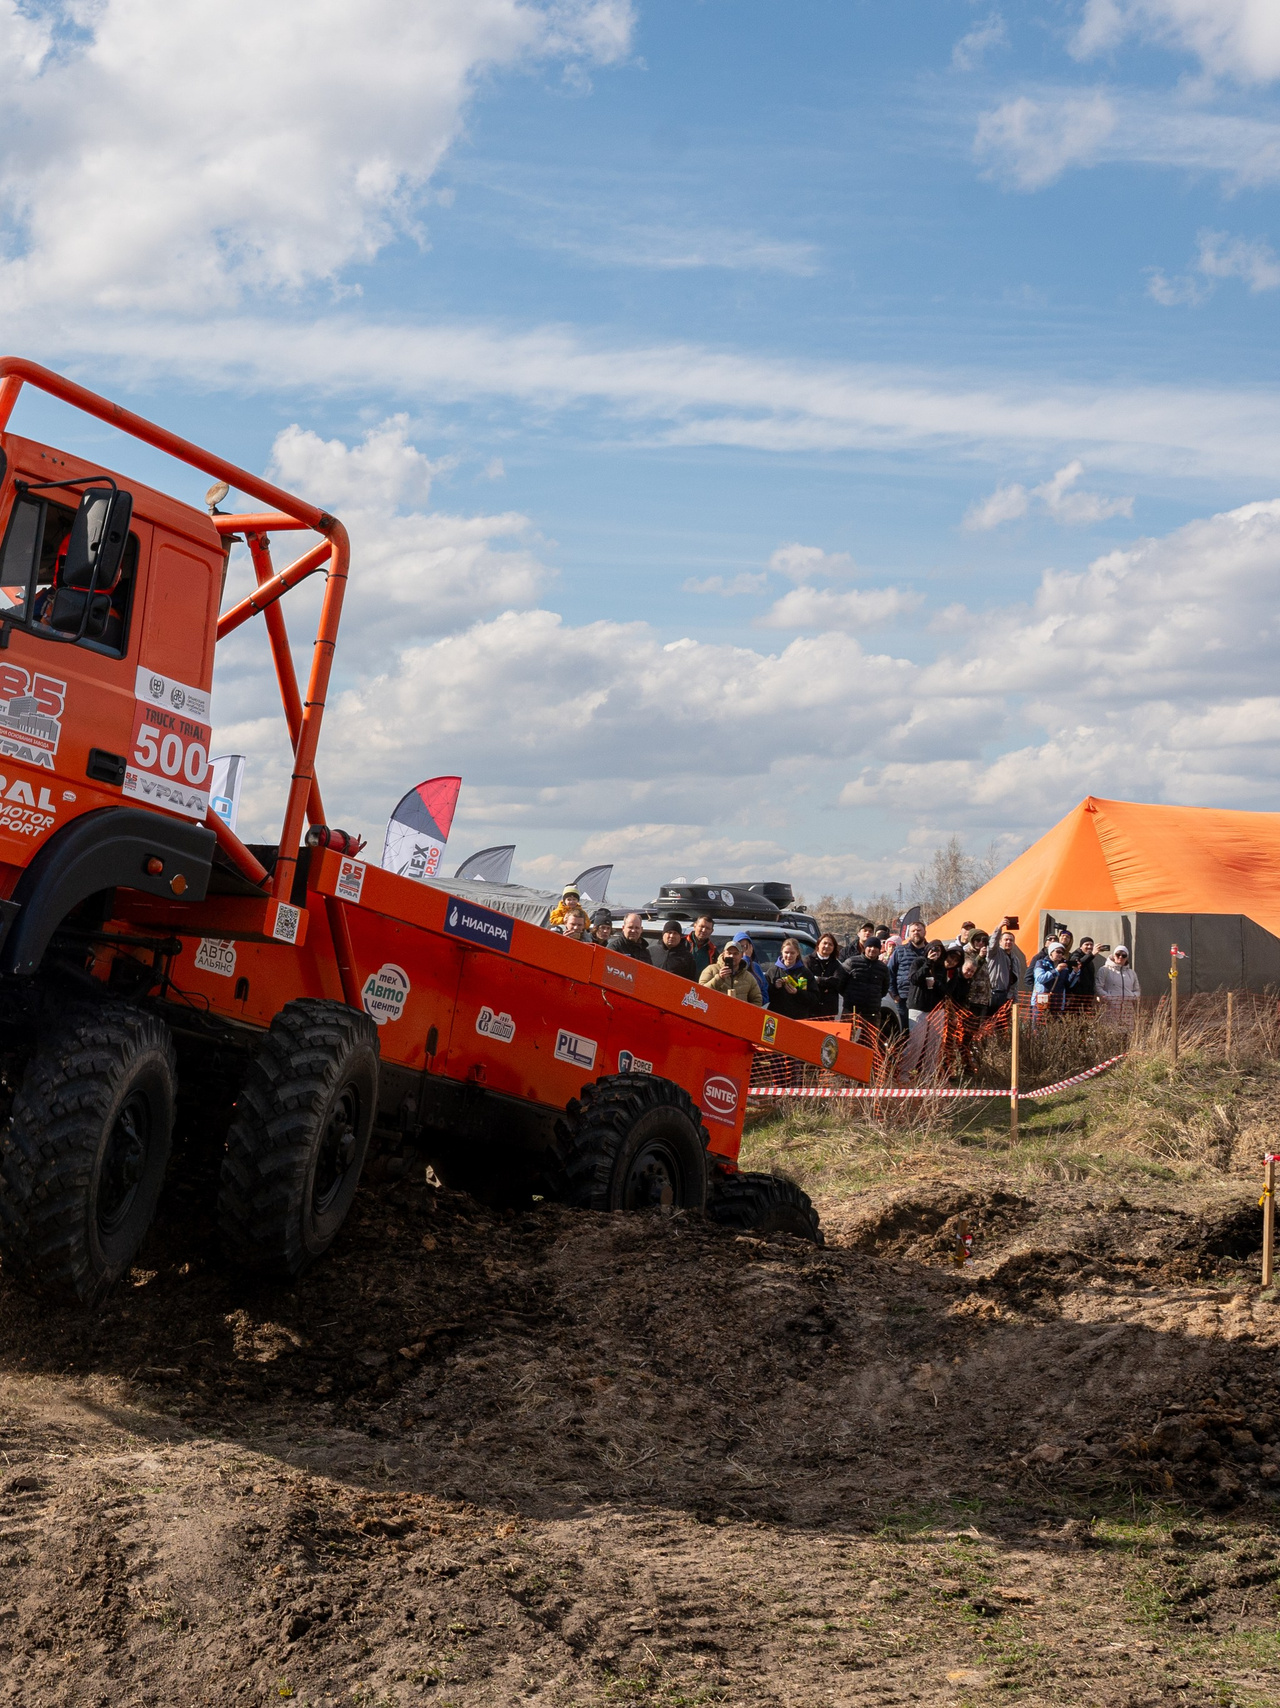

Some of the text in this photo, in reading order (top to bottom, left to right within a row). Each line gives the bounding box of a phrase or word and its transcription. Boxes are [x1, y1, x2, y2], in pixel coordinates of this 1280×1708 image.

[145, 708, 206, 742] TRUCK TRIAL
[133, 723, 209, 785] 500
[342, 862, 363, 880] 85
[461, 915, 508, 941] НИАГАРА
[200, 944, 234, 963] АВТО
[198, 956, 232, 972] АЛЬЯНС
[365, 979, 404, 1003] Авто
[371, 1000, 400, 1016] центр
[622, 1058, 630, 1069] FT
[633, 1060, 652, 1072] FORCE
[705, 1085, 737, 1105] SINTEC
